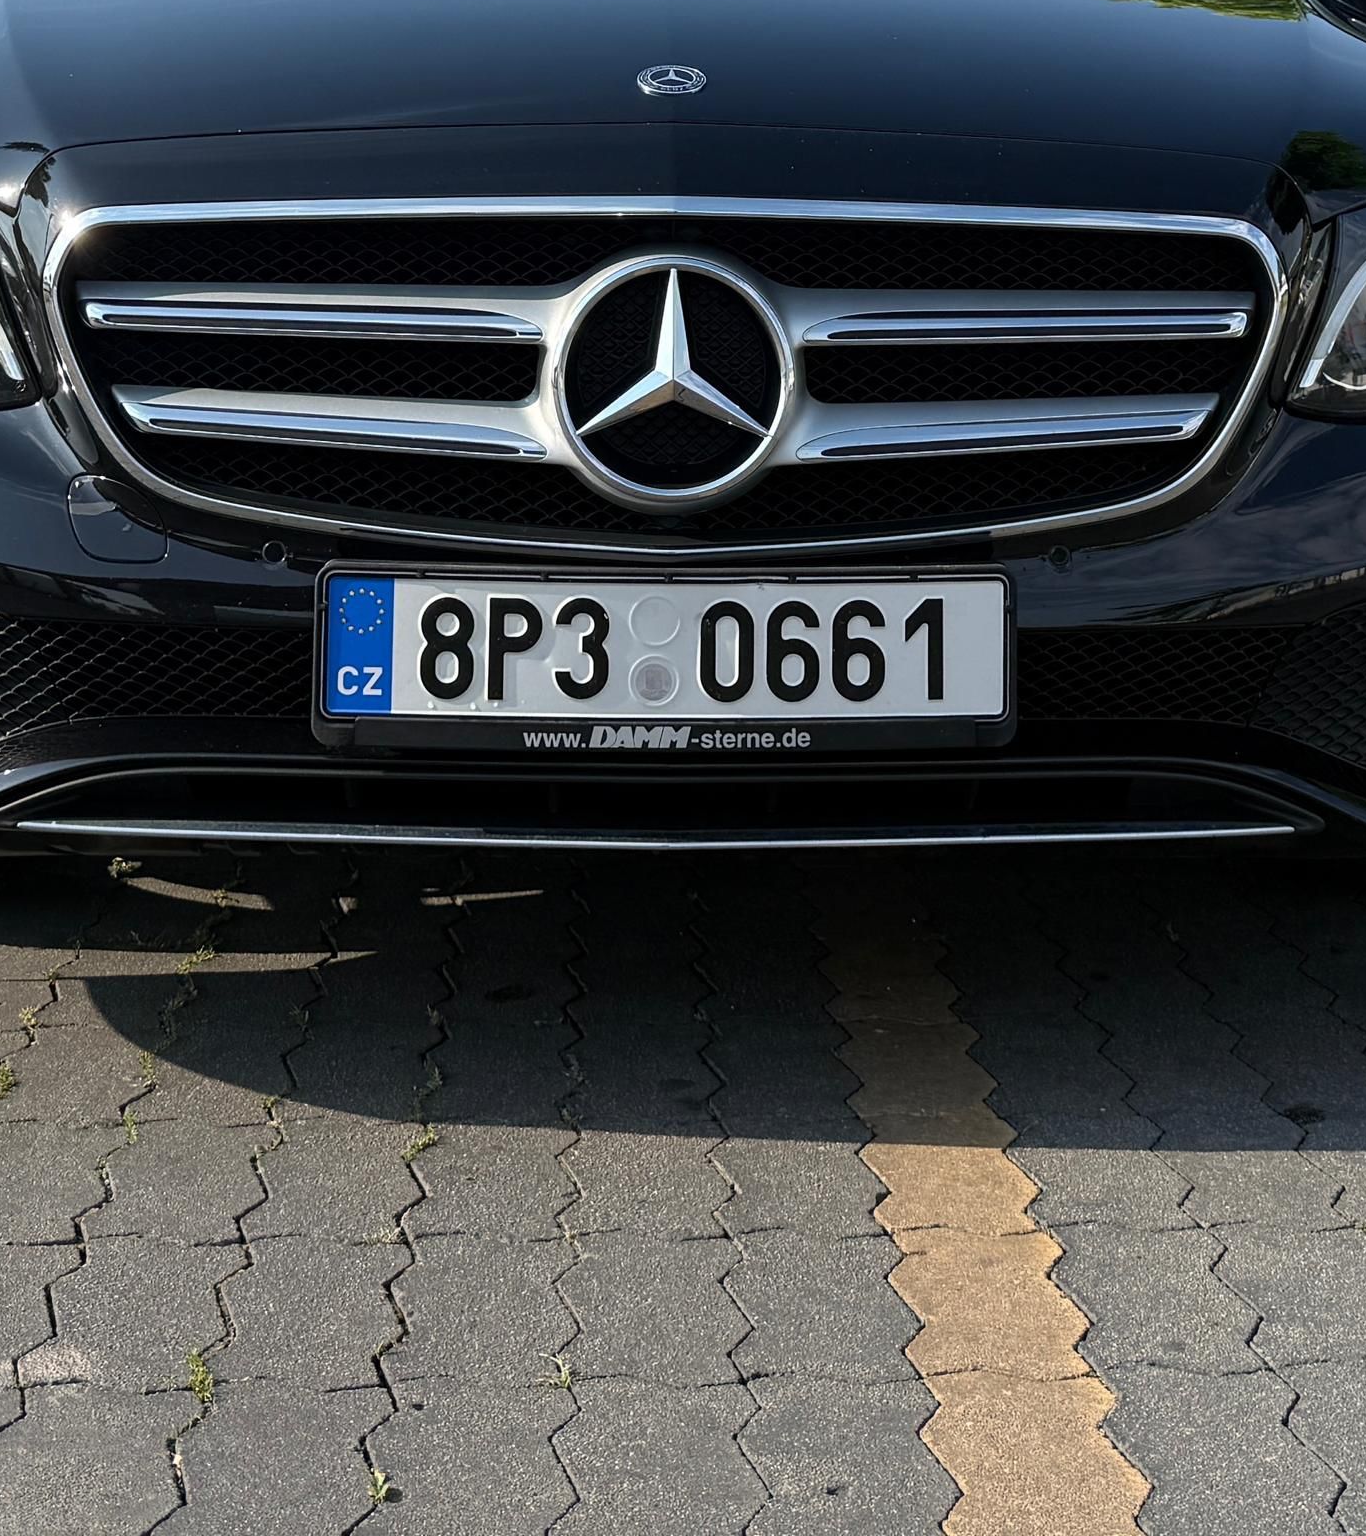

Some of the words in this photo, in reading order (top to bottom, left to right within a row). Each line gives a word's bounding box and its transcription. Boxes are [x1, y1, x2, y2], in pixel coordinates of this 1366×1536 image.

[419, 596, 610, 701] 8P3
[699, 597, 945, 704] 0661
[337, 665, 383, 696] CZ
[523, 725, 812, 749] www.DAMM-sterne.de
